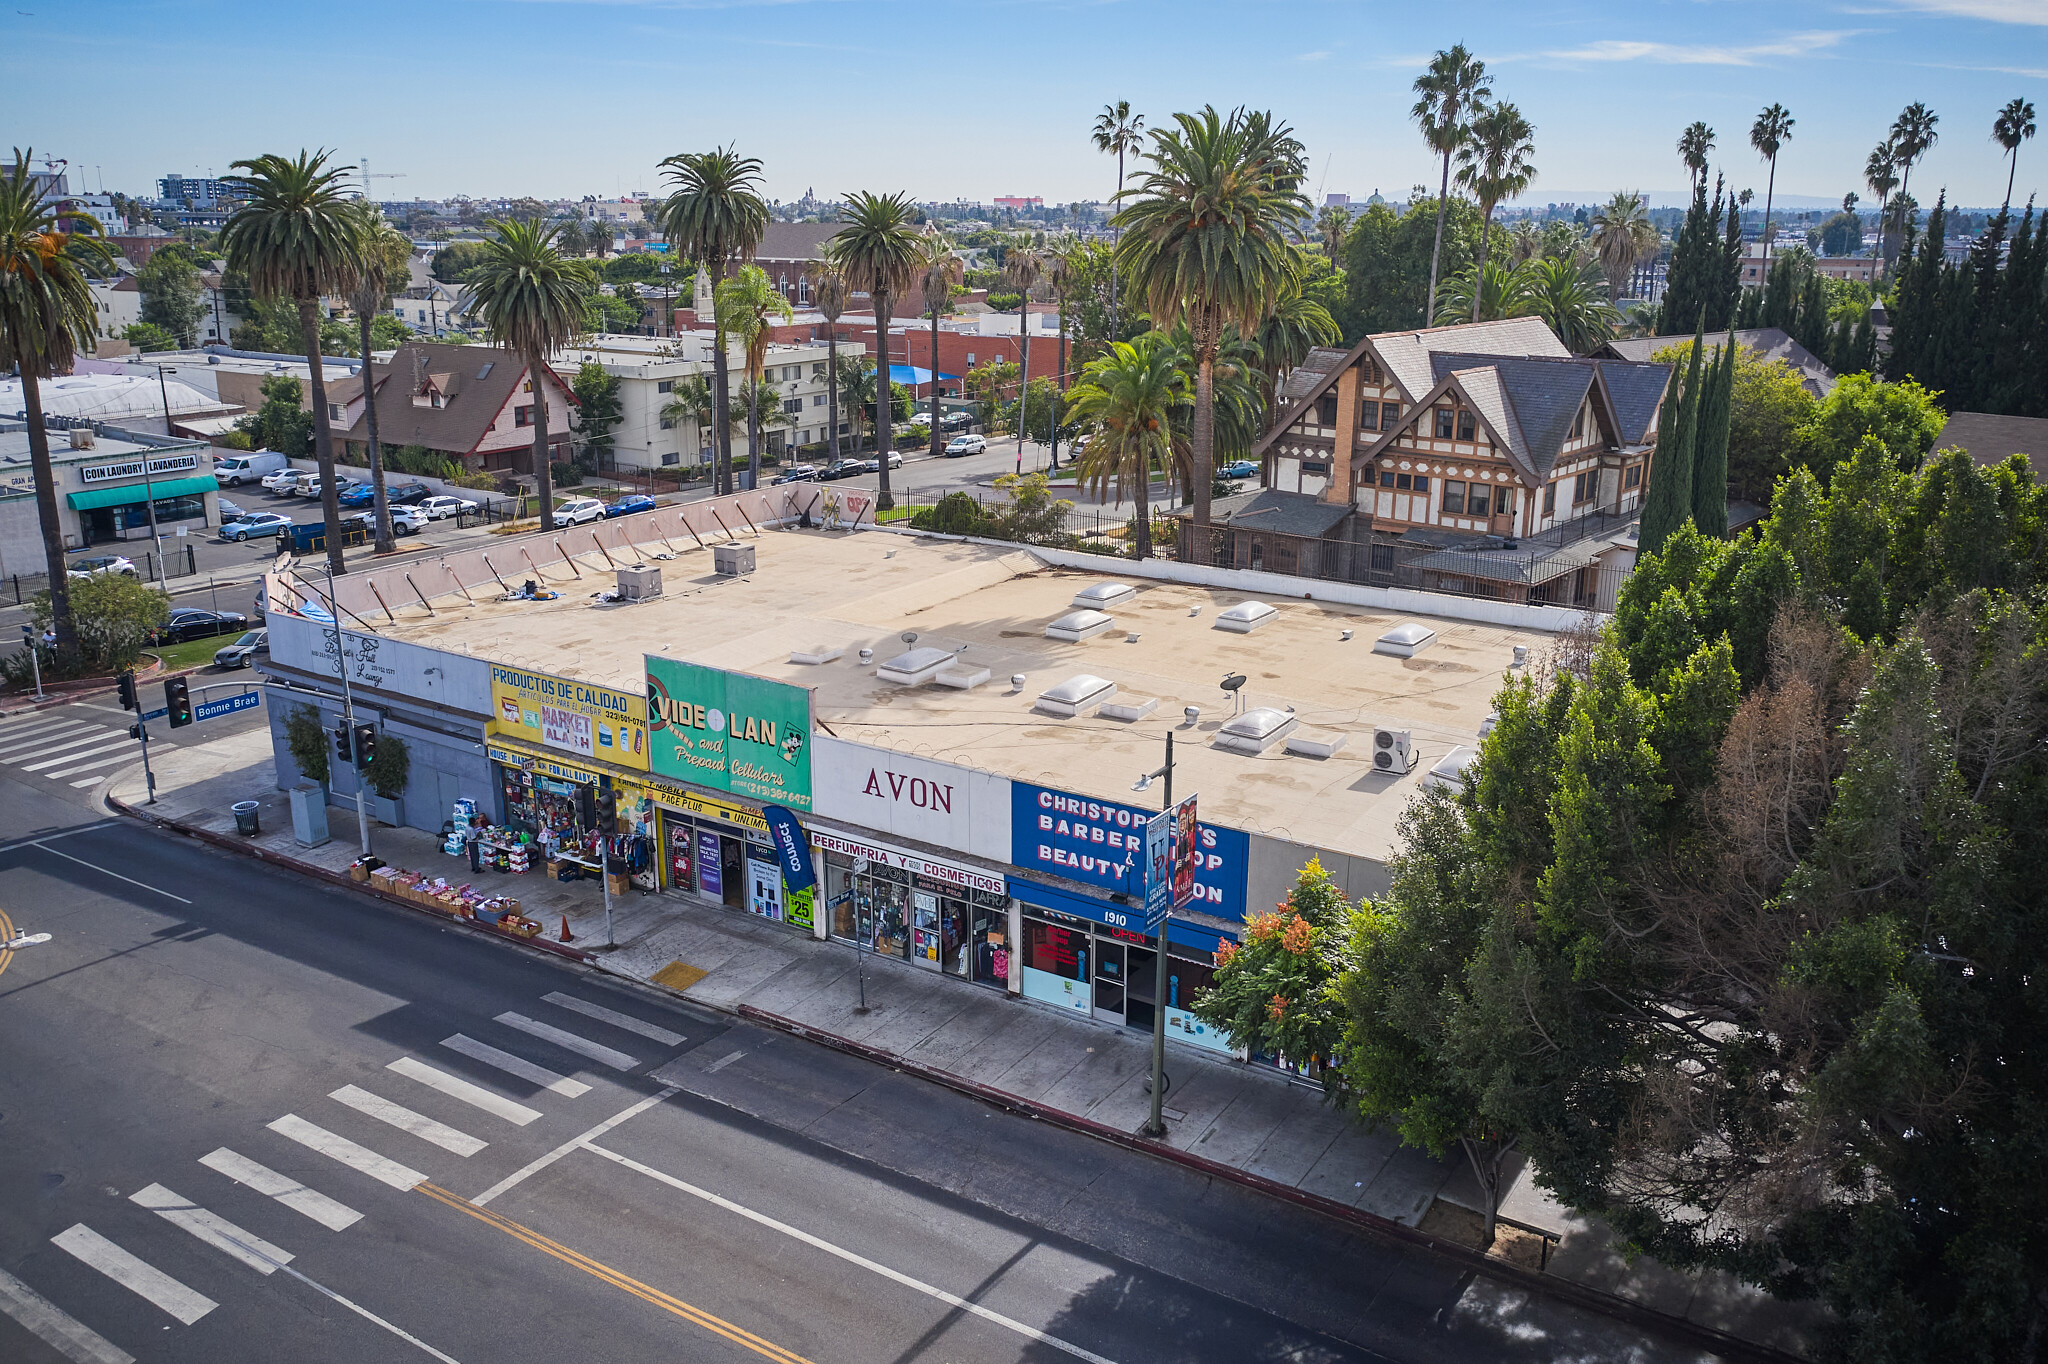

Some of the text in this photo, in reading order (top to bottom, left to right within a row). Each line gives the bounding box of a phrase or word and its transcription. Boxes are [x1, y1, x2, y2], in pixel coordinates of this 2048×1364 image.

[85, 457, 195, 479] COIN LAUNDRY LAVANDERIA
[11, 477, 26, 485] GRAN
[492, 667, 627, 713] PRODUCTOS DE CALIDAD
[198, 695, 257, 717] Bonnie Brae
[517, 689, 601, 717] ARTICULOS PARA EL HOGAR
[541, 705, 591, 736] MARKET
[729, 712, 776, 747] LAN
[489, 748, 508, 762] HOUSE
[698, 738, 725, 754] and
[548, 763, 561, 776] FOR
[561, 767, 573, 779] ALL
[574, 771, 598, 786] BABY'S
[674, 745, 785, 787] Prepaid Cellulars
[648, 781, 687, 798] T-MOBILE
[788, 790, 811, 805] 6427
[861, 767, 954, 814] AVON
[682, 798, 703, 813] PLUS
[734, 813, 768, 831] UNLIMIT
[1038, 814, 1141, 852] BARBER
[779, 821, 802, 872] connect
[1038, 844, 1126, 880] BEAUTY
[1125, 851, 1135, 867] &
[873, 863, 909, 882] AVON
[898, 856, 908, 868] Y
[923, 863, 1002, 893] COSMETICOS
[1104, 911, 1127, 927] 1910
[1111, 927, 1146, 944] OPEN
